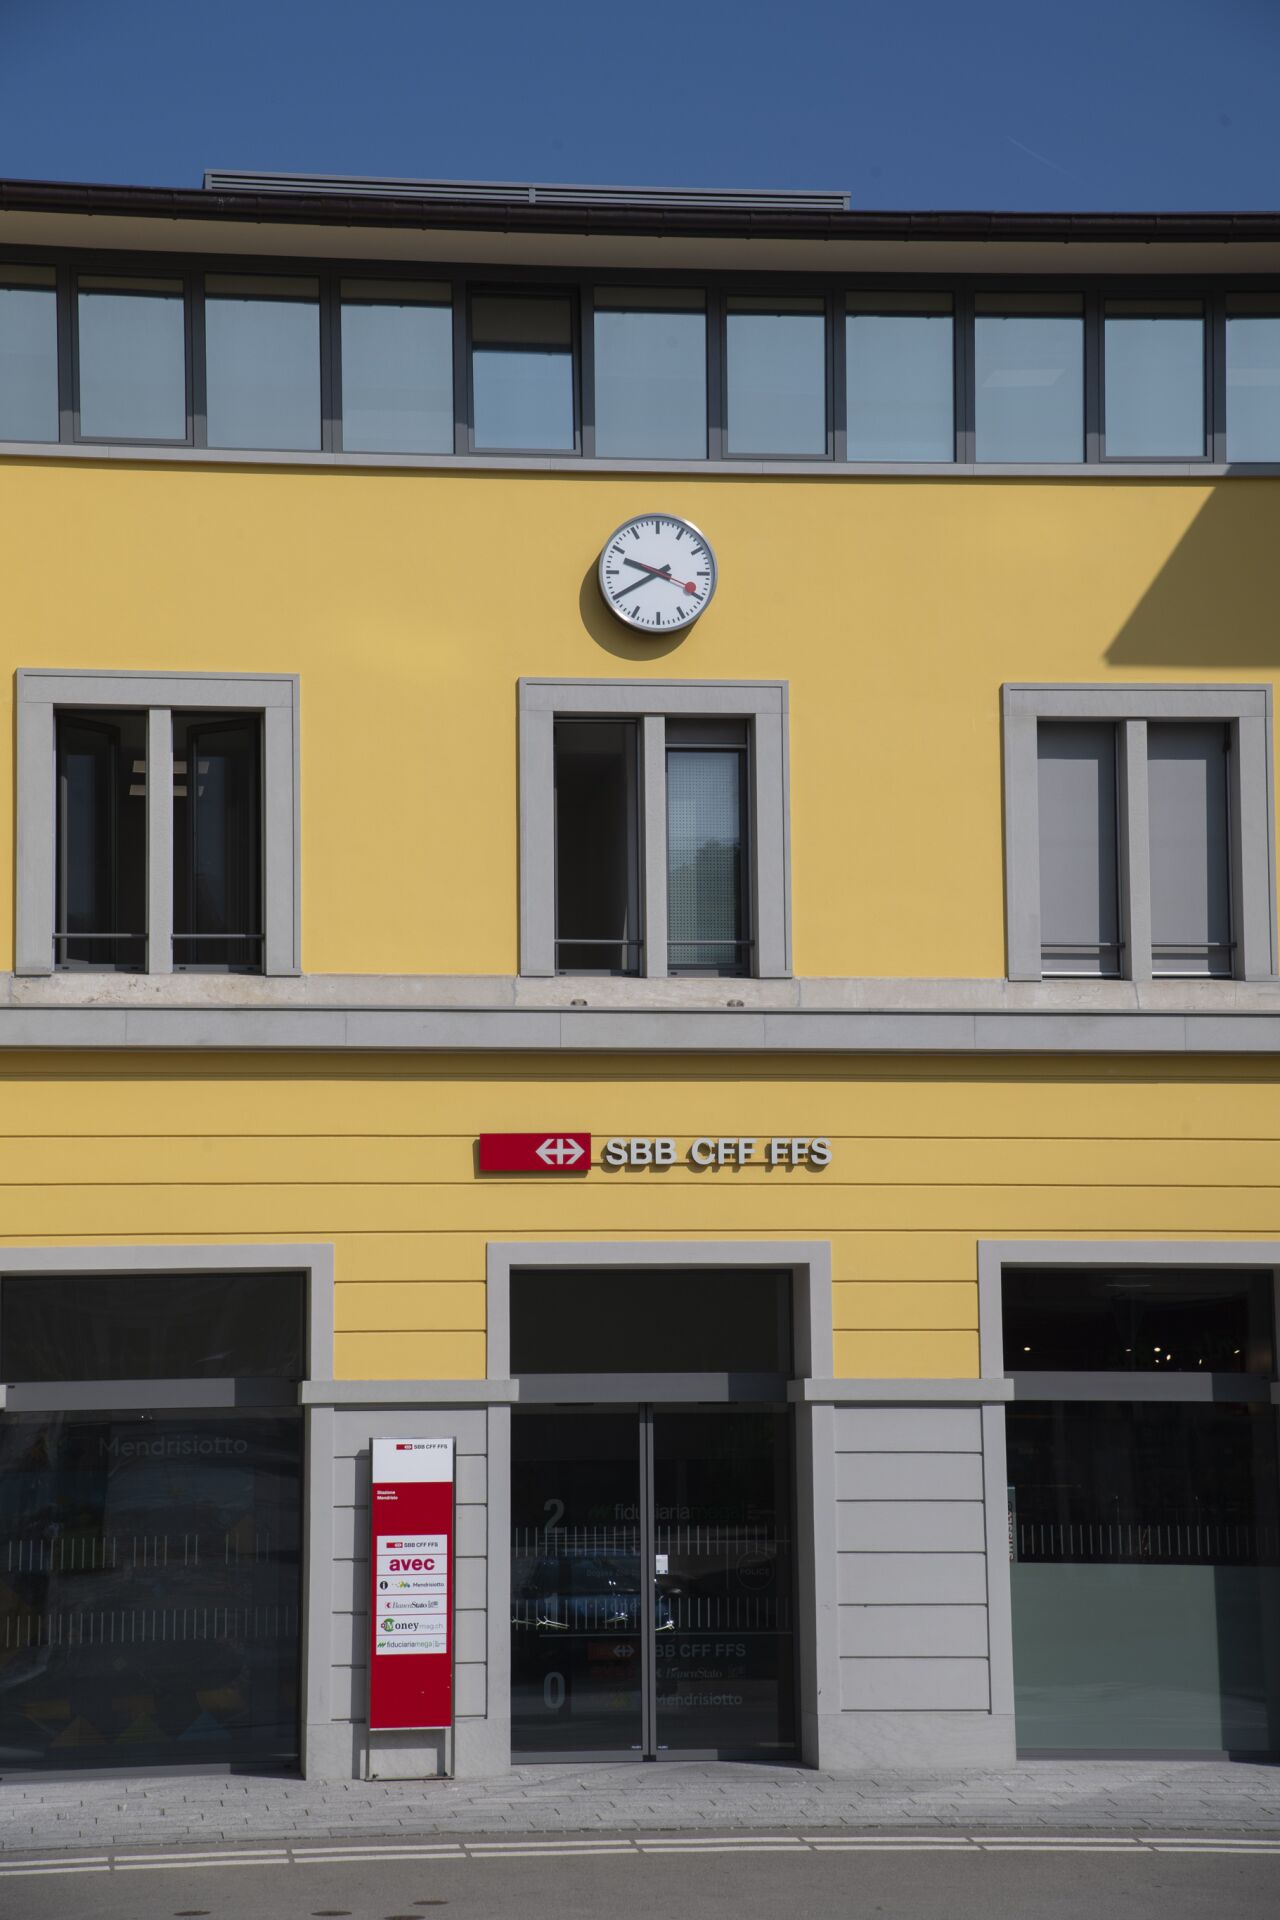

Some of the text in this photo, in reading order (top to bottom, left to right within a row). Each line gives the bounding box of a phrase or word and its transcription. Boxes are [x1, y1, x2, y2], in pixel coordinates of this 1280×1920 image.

[606, 1137, 833, 1166] SBB CFF FFS
[99, 1435, 248, 1457] Mendrisiotto
[543, 1498, 565, 1533] 2
[389, 1558, 435, 1571] avec
[655, 1642, 747, 1658] BB CFF FFS
